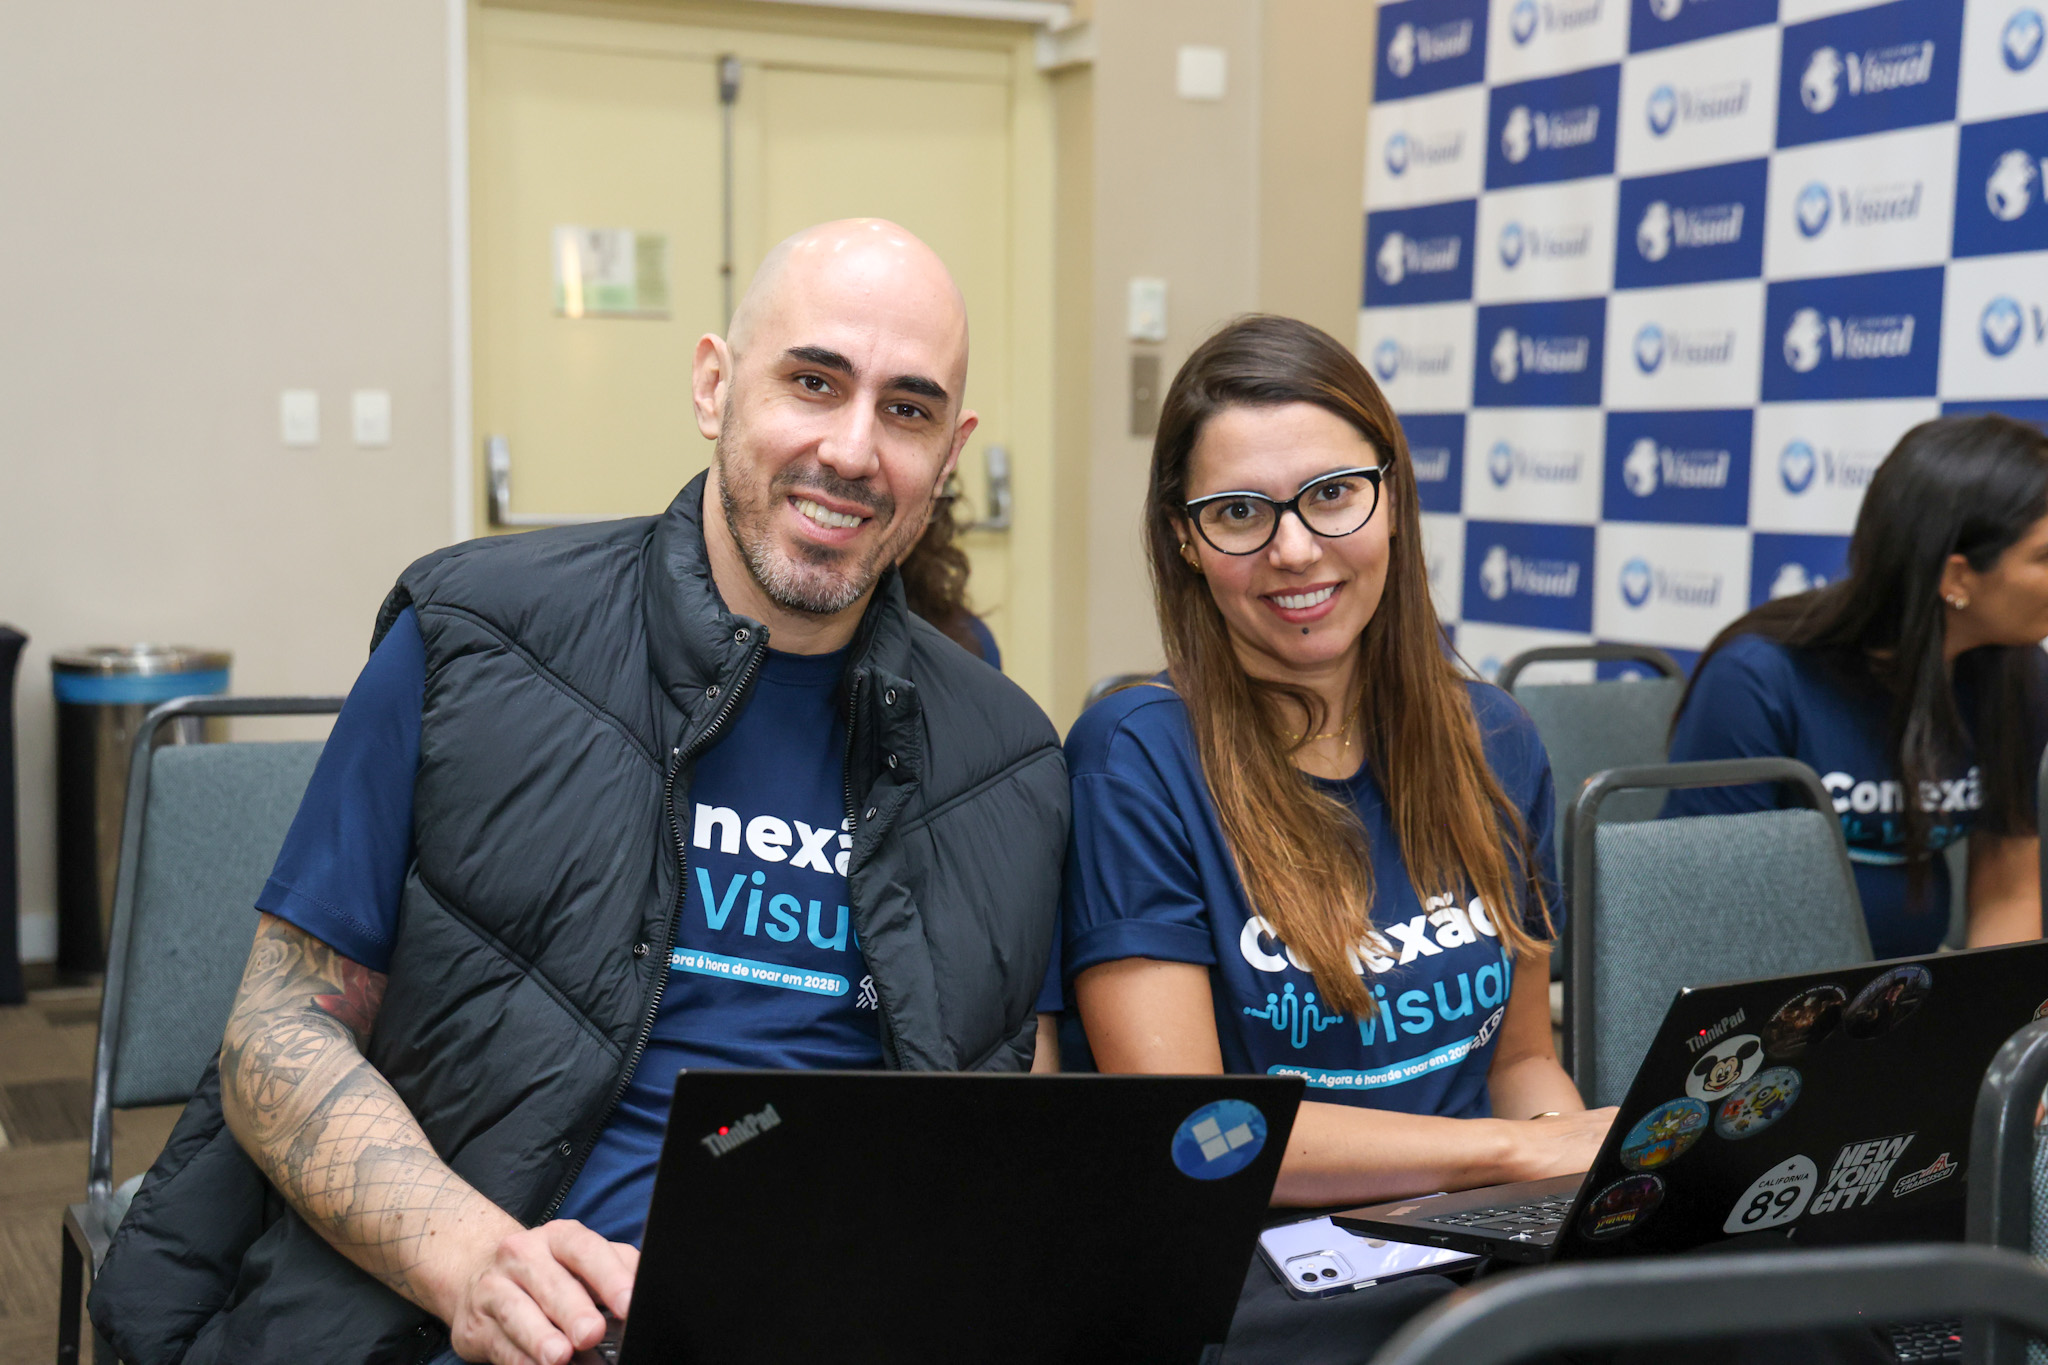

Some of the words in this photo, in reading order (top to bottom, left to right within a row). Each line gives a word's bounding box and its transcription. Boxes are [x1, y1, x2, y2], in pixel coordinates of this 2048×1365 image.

[1846, 40, 1935, 96] Visual
[1838, 181, 1923, 227] Visual
[1672, 202, 1744, 248] Visual
[1519, 335, 1589, 374] Visual
[1828, 315, 1915, 360] Visual
[1411, 450, 1450, 482] sual
[1660, 449, 1730, 488] Visual
[1822, 450, 1878, 488] Visu
[1508, 556, 1581, 597] Visual
[1821, 766, 1983, 814] Conexã
[693, 802, 855, 878] nexã
[695, 867, 861, 952] Visu
[1240, 891, 1500, 975] Cexão
[670, 953, 695, 967] ora
[705, 958, 730, 974] hora
[732, 963, 749, 977] de
[752, 967, 782, 983] voar
[782, 973, 803, 986] em
[804, 974, 841, 993] 2025!
[1685, 1007, 1746, 1053] ThinkPad
[1318, 1073, 1353, 1088] Agora
[1364, 1073, 1388, 1086] hora
[1387, 1068, 1402, 1082] de
[1403, 1061, 1430, 1077] voar
[1428, 1053, 1449, 1068] em
[700, 1103, 781, 1157] ThinkPad
[1833, 1135, 1915, 1170] NEW
[1758, 1173, 1810, 1189] CALIFORNIA
[1824, 1158, 1898, 1192] YORK
[1898, 1174, 1919, 1188] SAN
[1900, 1167, 1951, 1193] FRANCISCO
[1741, 1185, 1801, 1226] 89
[1809, 1181, 1885, 1216] CITY
